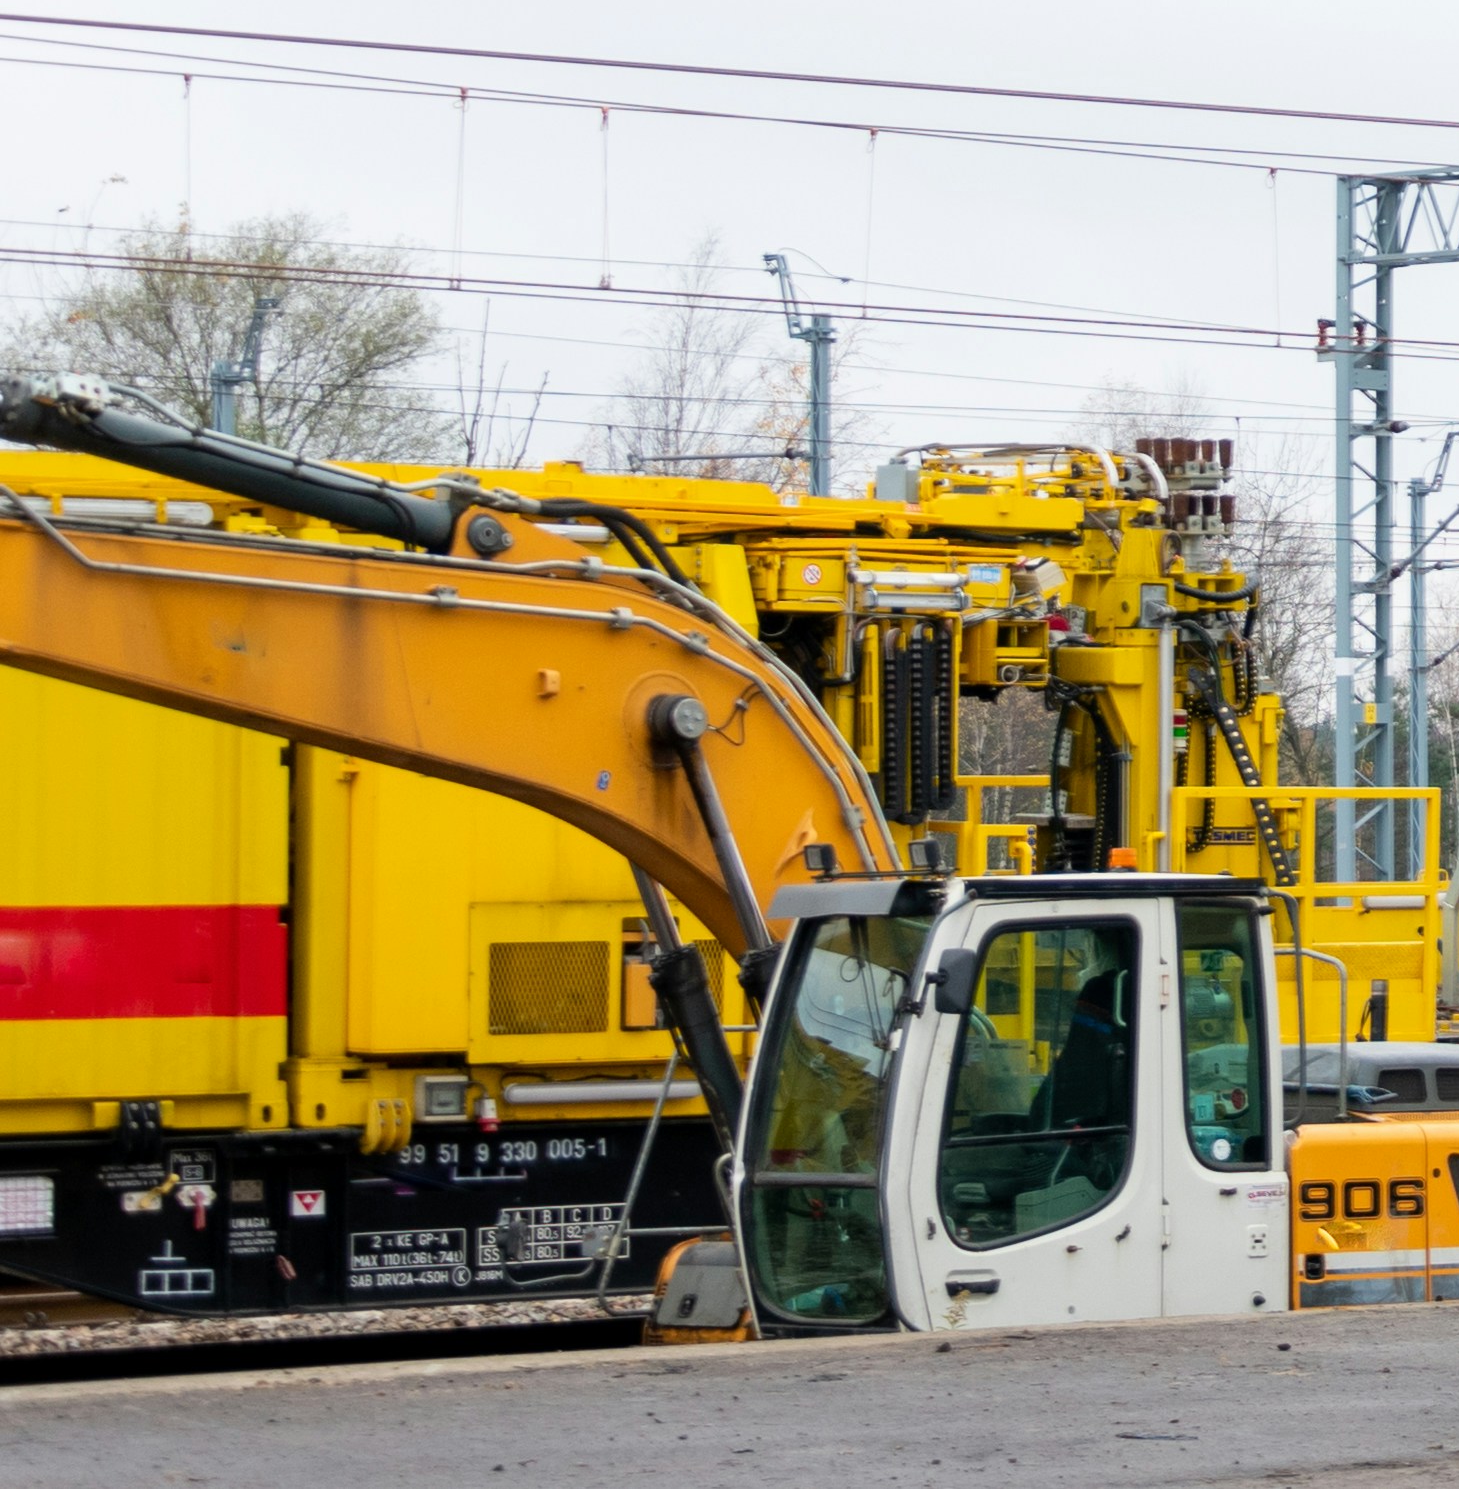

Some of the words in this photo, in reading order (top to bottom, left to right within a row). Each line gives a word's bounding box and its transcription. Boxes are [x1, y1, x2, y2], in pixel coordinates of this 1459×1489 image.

[1192, 830, 1255, 844] TSMEC
[399, 1144, 426, 1164] 99
[437, 1143, 459, 1164] 51
[476, 1142, 490, 1163] 9
[501, 1140, 537, 1162] 330
[548, 1137, 608, 1160] 005-1
[1299, 1177, 1426, 1222] 906
[543, 1210, 552, 1224] B
[572, 1208, 582, 1222] C
[602, 1207, 613, 1221] D
[371, 1235, 382, 1248] 2
[396, 1234, 413, 1247] KE
[418, 1233, 449, 1246] GP-A
[487, 1230, 496, 1244] S
[353, 1255, 378, 1267] MAX
[483, 1248, 500, 1262] SS
[350, 1275, 373, 1287] SAB
[377, 1271, 449, 1286] DRV2A-450H
